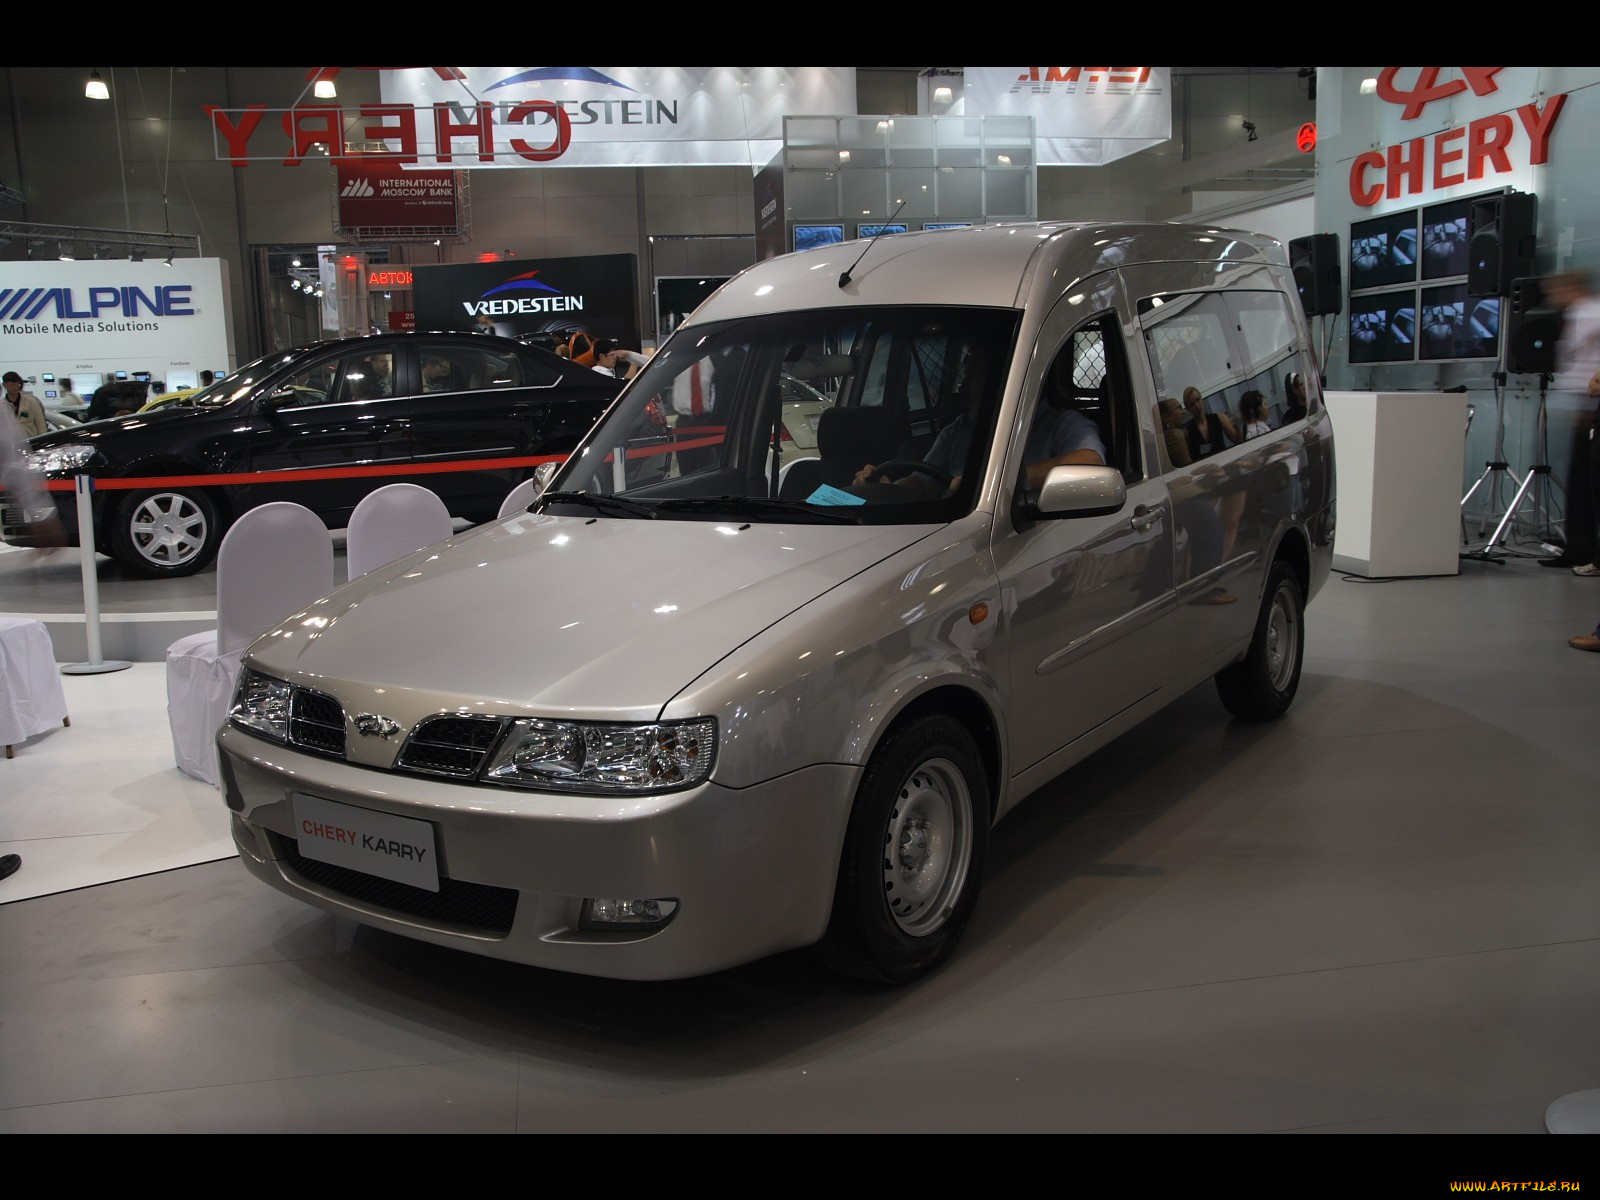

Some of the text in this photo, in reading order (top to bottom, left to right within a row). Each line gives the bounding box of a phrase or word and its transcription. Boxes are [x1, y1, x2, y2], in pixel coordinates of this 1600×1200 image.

[1349, 94, 1568, 207] CHERY
[379, 179, 453, 188] INTERNATIONAL
[381, 188, 453, 197] MOSCOW BANK
[14, 285, 195, 320] ALPINE
[463, 295, 583, 316] VREDESTEIN
[3, 320, 159, 335] Mobile Media Solutions
[302, 819, 426, 863] CHERY KARRY
